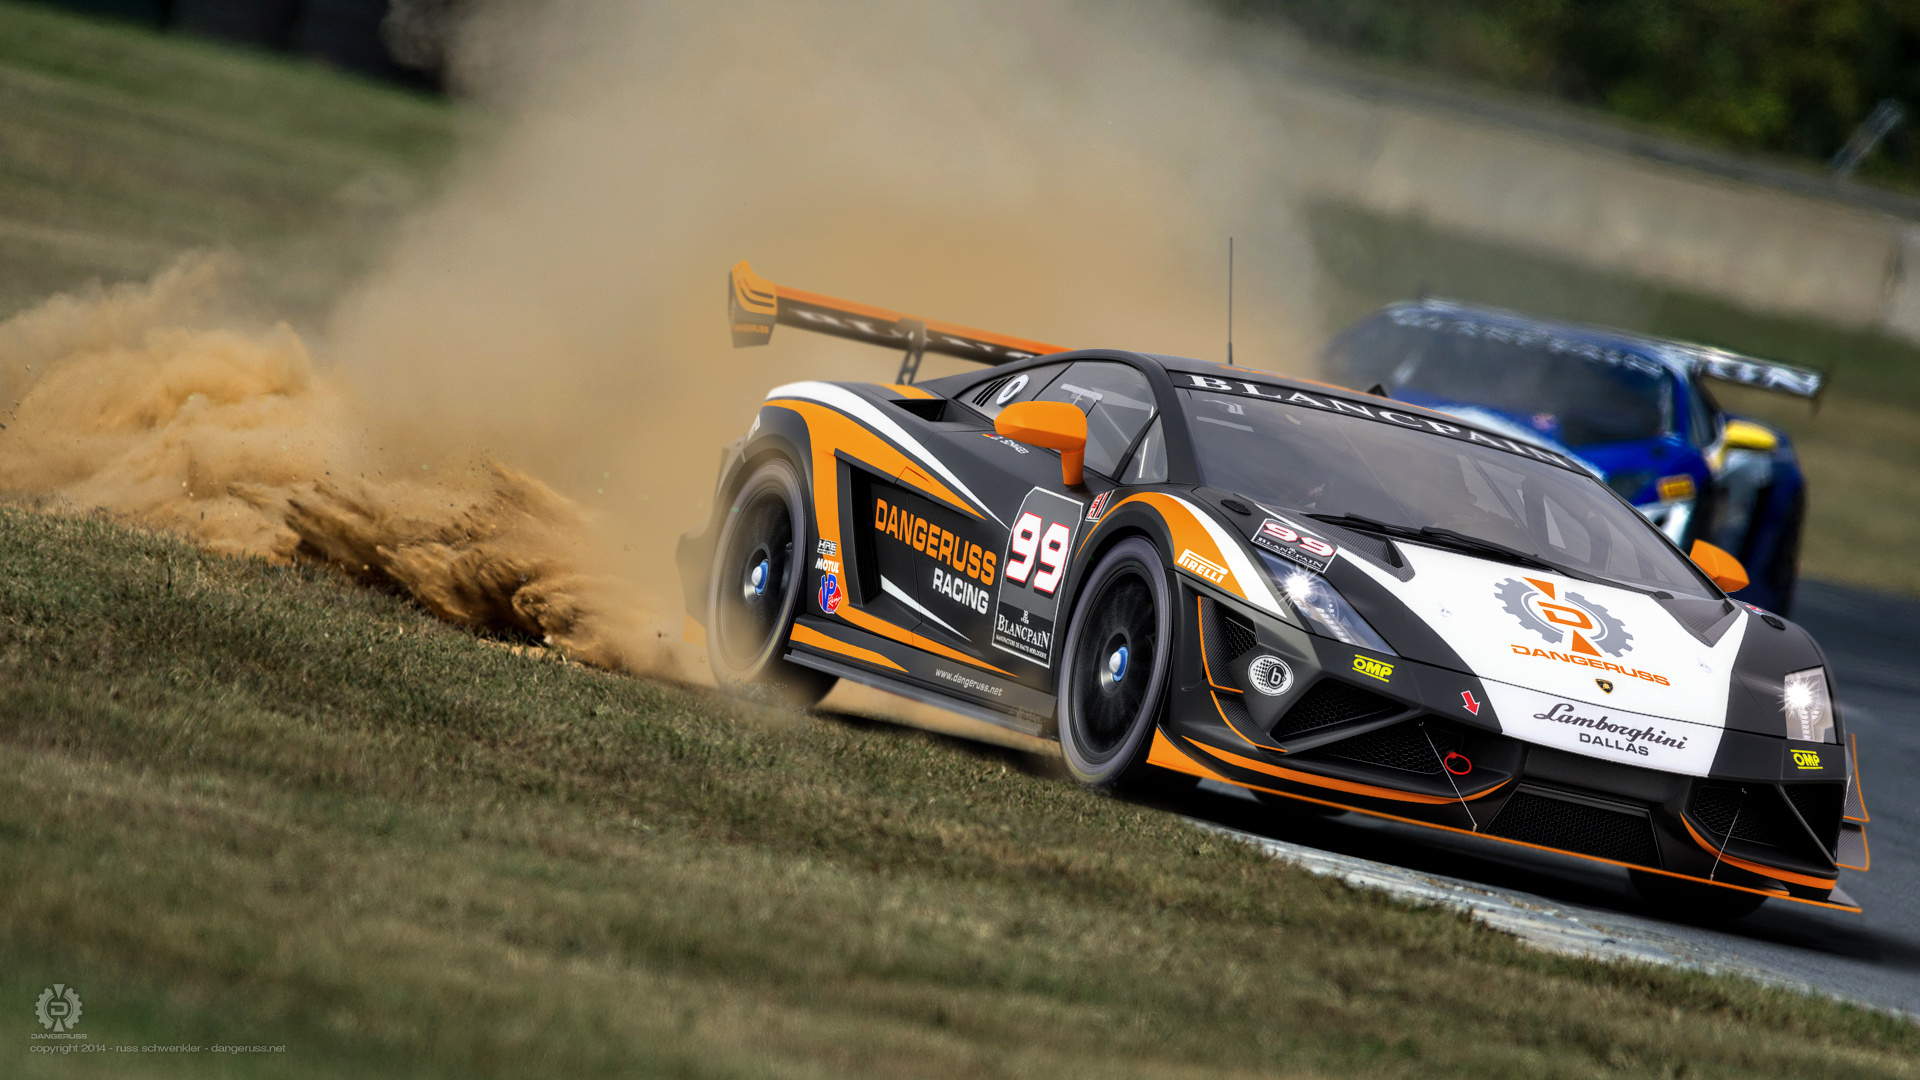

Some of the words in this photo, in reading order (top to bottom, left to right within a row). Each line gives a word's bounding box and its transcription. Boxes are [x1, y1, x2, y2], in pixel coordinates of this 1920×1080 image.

[1186, 374, 1571, 468] BLANCPAIN
[818, 539, 837, 551] HRE
[875, 498, 997, 586] DANGERUSS
[1005, 511, 1071, 595] 99
[1257, 537, 1324, 568] BLANCPAIN
[1262, 522, 1335, 557] 99
[815, 558, 839, 574] MOTUL
[1177, 548, 1229, 584] PIRELLI
[821, 573, 837, 612] VP
[932, 567, 990, 615] RACING
[996, 613, 1051, 650] BLANCPAIN
[935, 668, 1003, 697] www.dangeruss.net
[1353, 656, 1394, 680] OMP
[1510, 643, 1672, 687] DANGERUSS
[1532, 703, 1689, 751] Lamborghini
[1579, 732, 1650, 757] DALLAS
[1793, 752, 1821, 767] OMP
